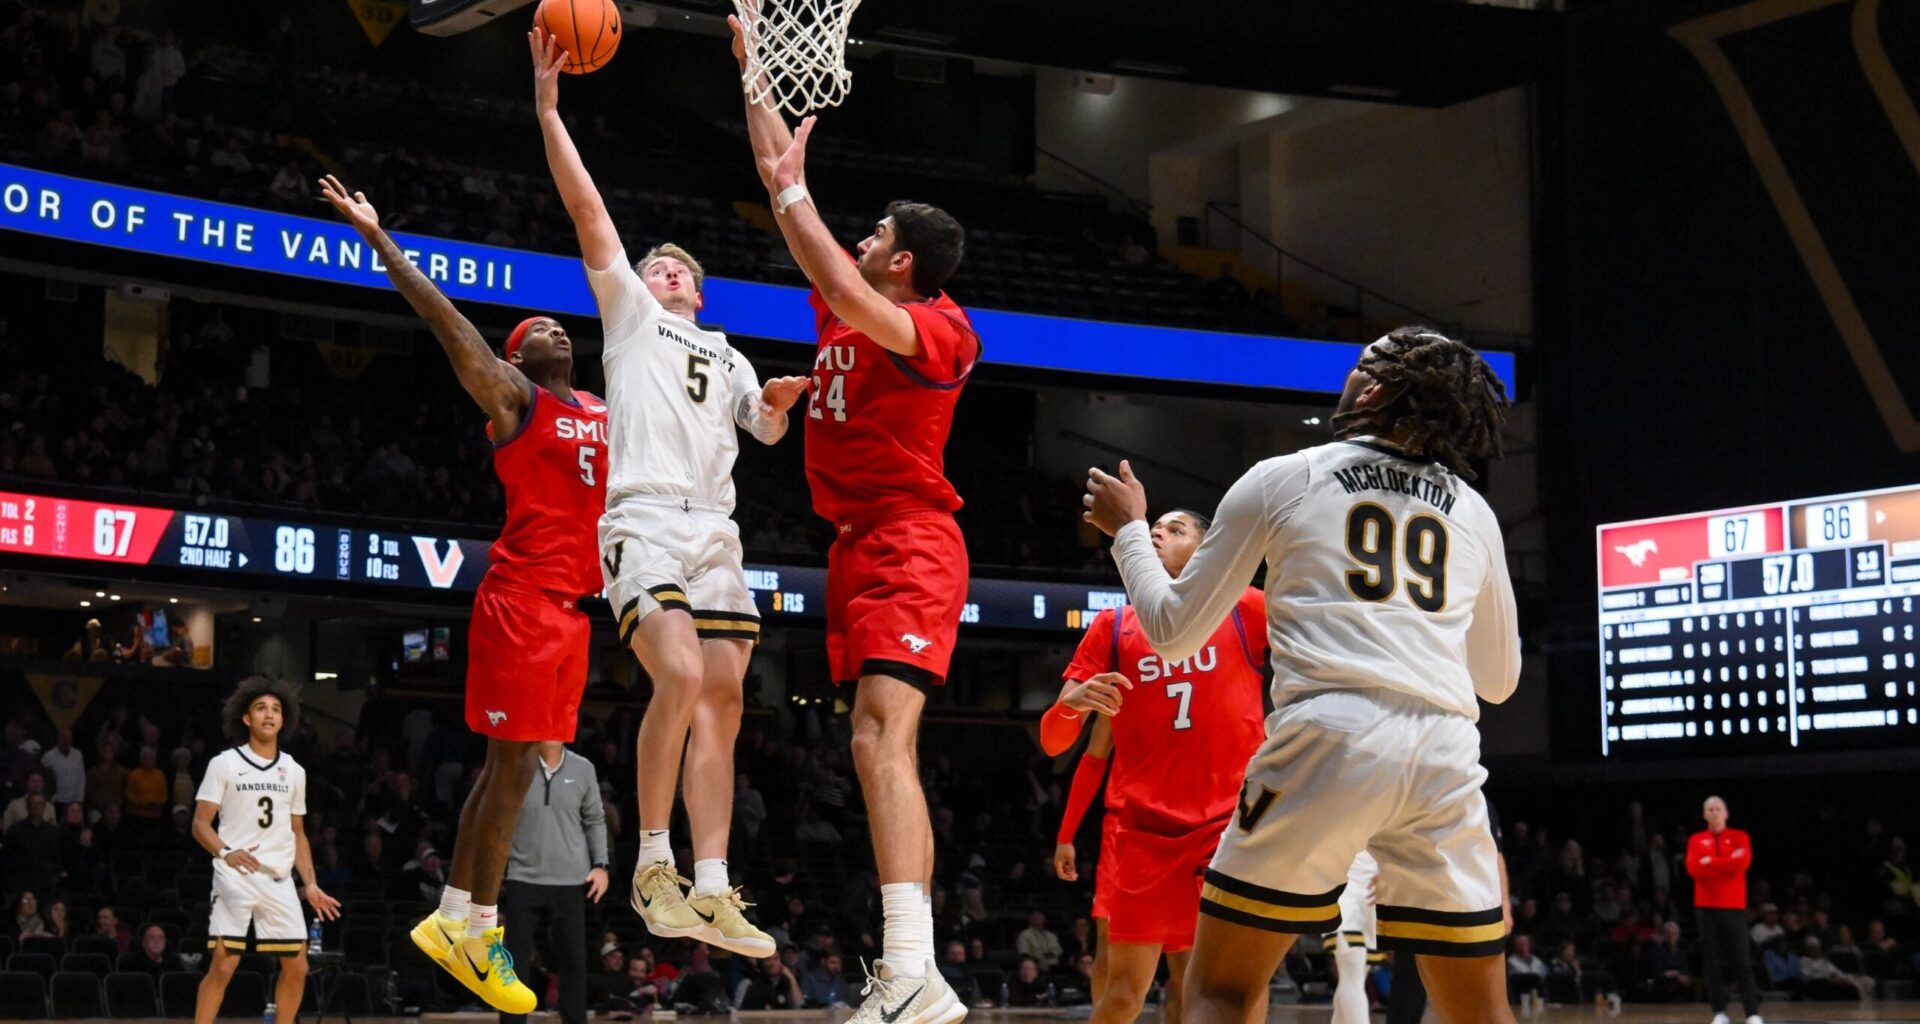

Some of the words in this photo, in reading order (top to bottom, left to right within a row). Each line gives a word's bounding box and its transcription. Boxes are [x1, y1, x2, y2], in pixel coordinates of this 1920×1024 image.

[4, 184, 60, 220] OR
[91, 199, 146, 233] OF
[172, 212, 254, 253] THE
[685, 351, 712, 406] 5
[809, 375, 847, 422] 24
[577, 446, 596, 487] 5
[1333, 463, 1457, 517] MCGLOCKTON
[1, 502, 19, 519] TOL
[24, 499, 35, 521] 2
[1823, 505, 1851, 541] 86
[1, 528, 18, 545] FLS
[23, 525, 34, 546] 9
[94, 508, 136, 557] 67
[184, 514, 230, 549] 57.0
[368, 533, 380, 555] 3
[383, 540, 400, 557] TOL
[1724, 518, 1749, 553] 67
[180, 546, 204, 566] 2ND
[204, 548, 232, 569] HALF
[275, 526, 316, 574] 86
[340, 533, 350, 576] BONUS
[1344, 501, 1451, 614] 99
[366, 557, 382, 579] 10
[382, 563, 399, 580] FLS
[1762, 553, 1815, 595] 57.0
[773, 591, 782, 612] 3
[783, 592, 804, 613] FLS
[1033, 595, 1046, 620] 5
[1136, 646, 1218, 683] SMU
[1166, 681, 1194, 731] 7
[235, 782, 289, 794] VANDERBILT
[257, 795, 274, 830] 3
